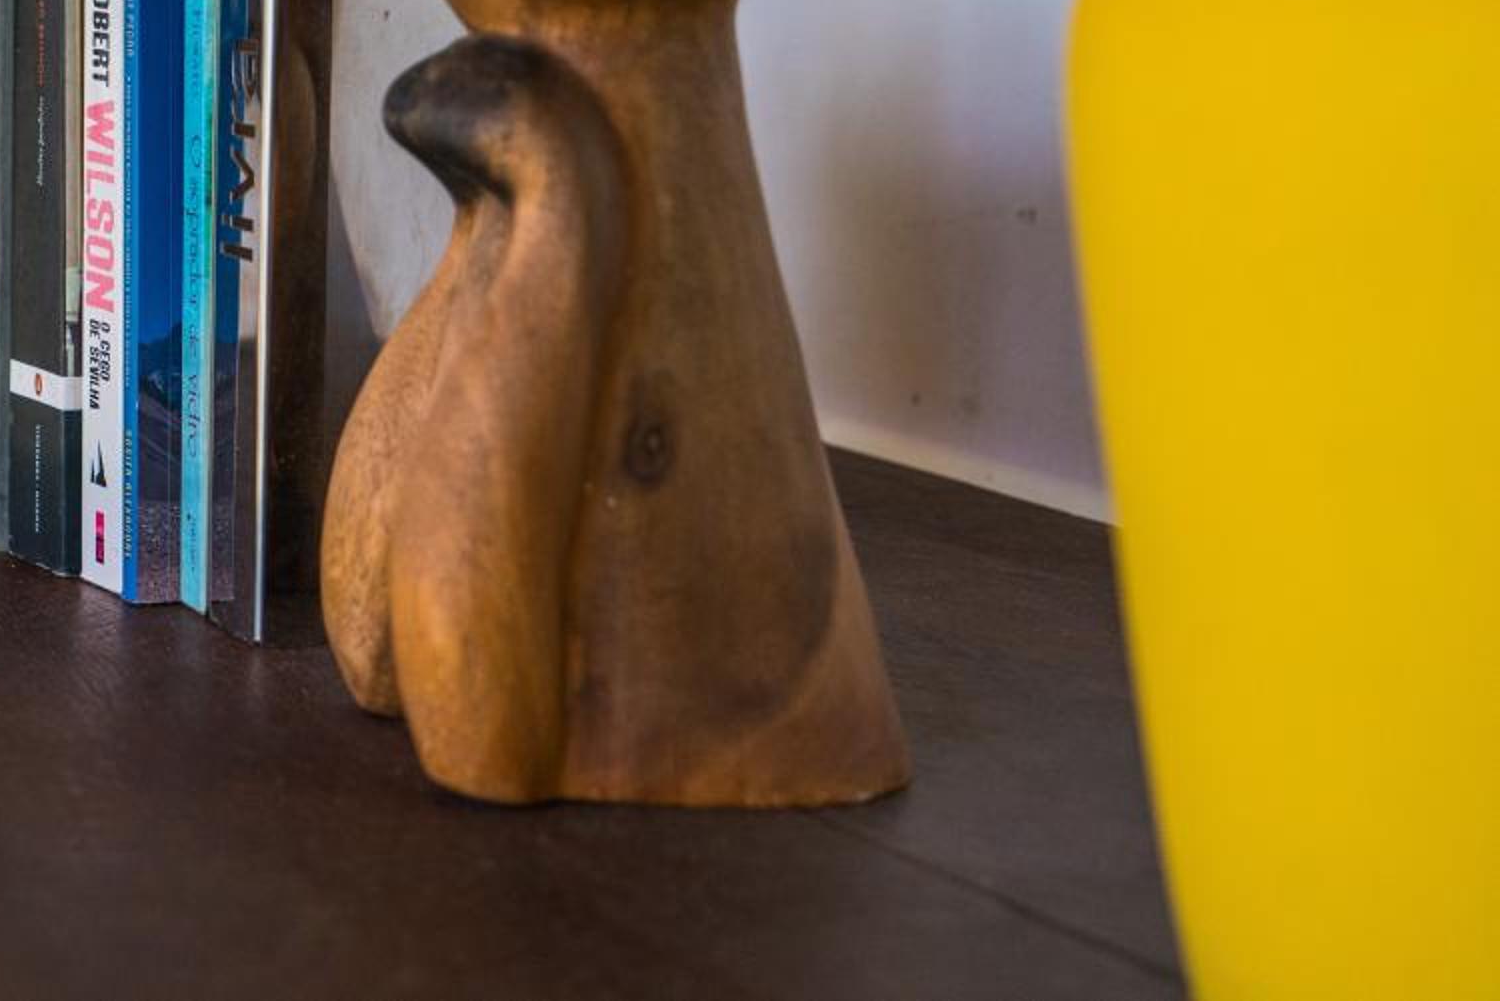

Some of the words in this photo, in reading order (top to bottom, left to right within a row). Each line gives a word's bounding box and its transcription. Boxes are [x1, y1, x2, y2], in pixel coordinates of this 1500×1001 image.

[86, 100, 115, 314] WILSON
[89, 319, 100, 340] DE
[99, 322, 112, 334] O
[89, 346, 100, 410] SEVILHA
[99, 340, 112, 382] CEGO
